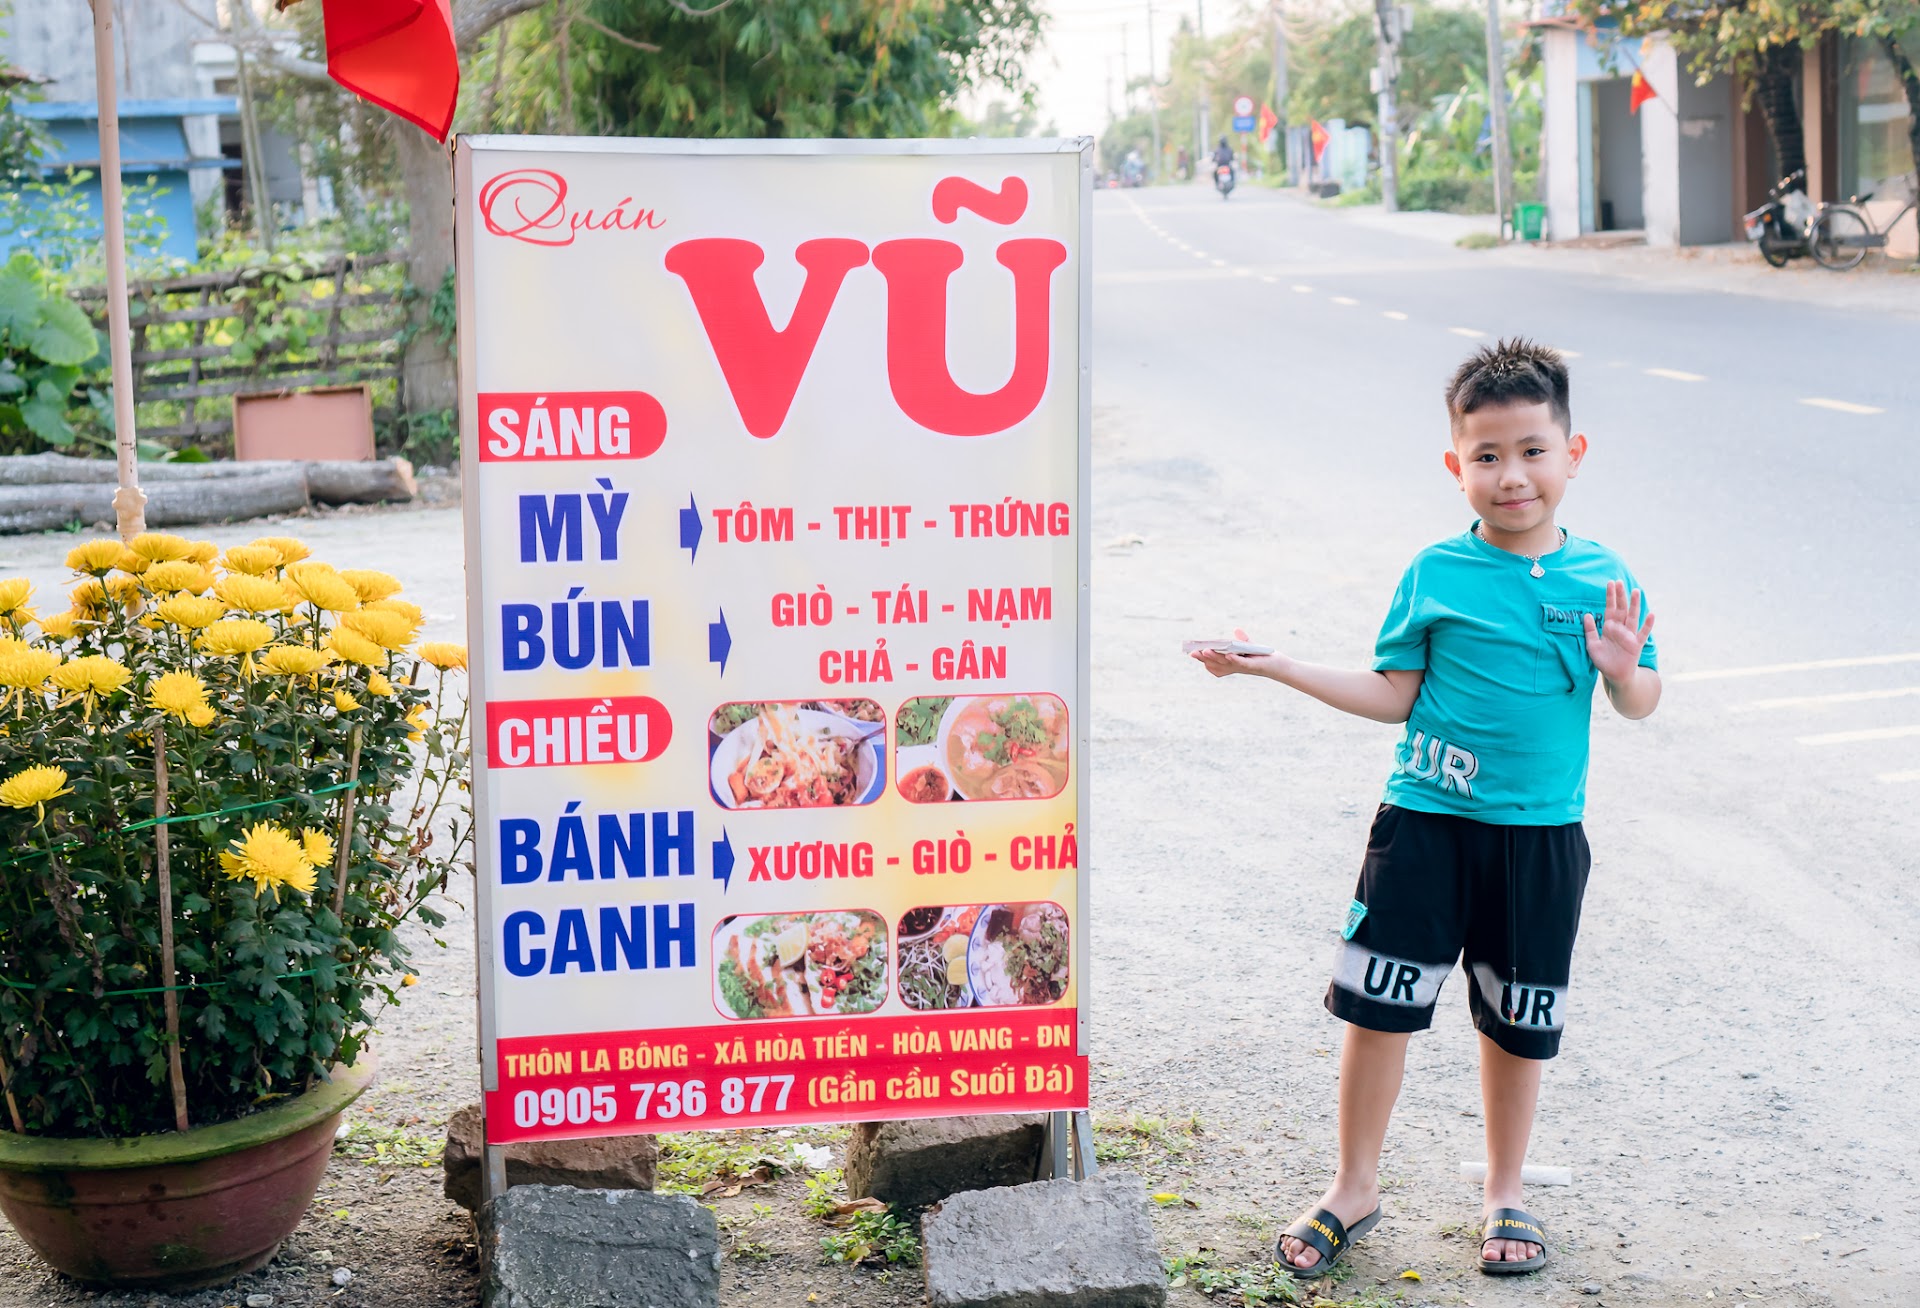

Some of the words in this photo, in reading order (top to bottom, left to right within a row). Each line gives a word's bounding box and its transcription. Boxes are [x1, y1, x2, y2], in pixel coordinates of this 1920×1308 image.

[479, 168, 667, 247] Quán
[664, 176, 1067, 440] VŨ
[488, 397, 631, 457] SÁNG
[519, 477, 630, 563] MỲ
[712, 501, 794, 544] TÔM
[833, 505, 912, 548] THỊT
[949, 496, 1070, 538] TRỨNG
[501, 586, 651, 672] BÚN
[771, 583, 834, 627] GIÒ
[871, 583, 928, 625] TÁI
[967, 586, 1053, 629] NẠM
[818, 637, 893, 685] CHẢ
[931, 640, 1007, 682] GÂN
[498, 699, 649, 766] CHIỀU
[1404, 728, 1479, 801] UR
[499, 801, 696, 885] BÁNH
[747, 840, 874, 883] XƯƠNG
[912, 830, 972, 873] GIÒ
[1010, 822, 1078, 872] CHẢ
[503, 903, 697, 978] CANH
[1363, 955, 1422, 1002] UR
[1500, 983, 1556, 1026] UR
[504, 1047, 573, 1079] THÔN
[580, 1049, 612, 1073] LA
[618, 1041, 689, 1071] BÔNG
[713, 1037, 748, 1065] XÃ
[754, 1033, 806, 1063] HÒA
[812, 1027, 868, 1060] TIẾN
[892, 1026, 942, 1055] HÒA
[949, 1026, 1013, 1053] VANG
[1036, 1024, 1071, 1048] ĐN
[513, 1085, 618, 1128] 0905
[629, 1079, 707, 1121] 736
[719, 1074, 796, 1115] 877
[808, 1070, 876, 1107] (Gần
[886, 1066, 940, 1099] cầu
[950, 1062, 1015, 1096] Suối
[1024, 1063, 1074, 1095] Đá)
